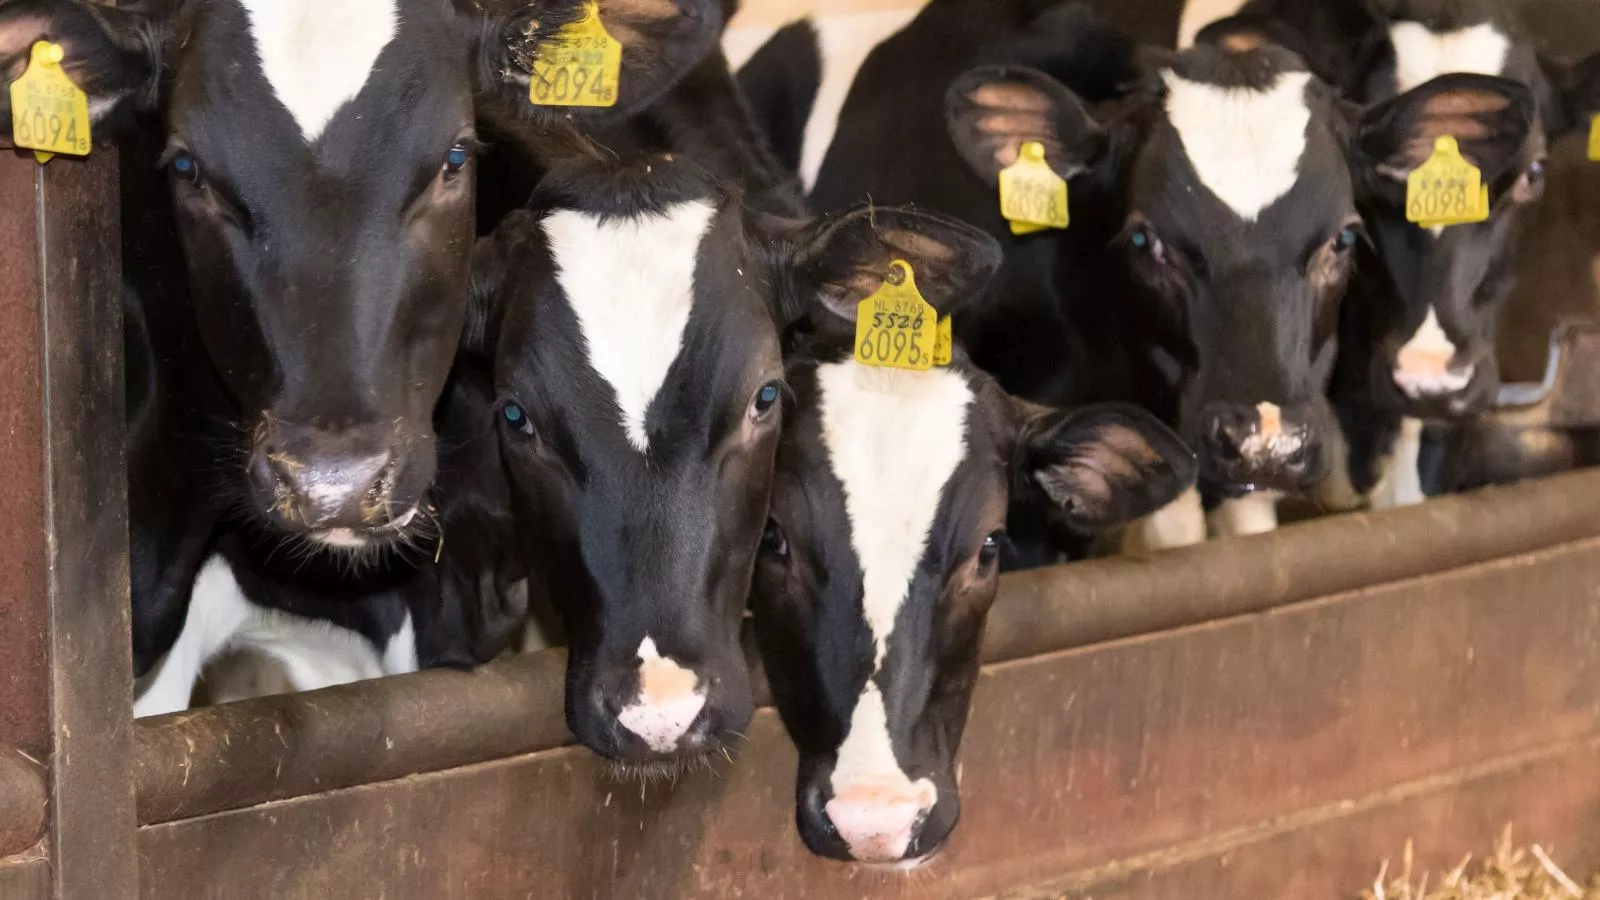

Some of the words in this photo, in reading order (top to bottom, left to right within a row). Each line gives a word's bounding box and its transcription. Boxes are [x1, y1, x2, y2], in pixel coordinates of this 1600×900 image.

[535, 66, 604, 101] 6094
[18, 107, 77, 151] 6094
[1410, 187, 1467, 217] 6098
[872, 312, 924, 330] 5526
[874, 299, 889, 311] NL
[860, 328, 922, 365] 6095
